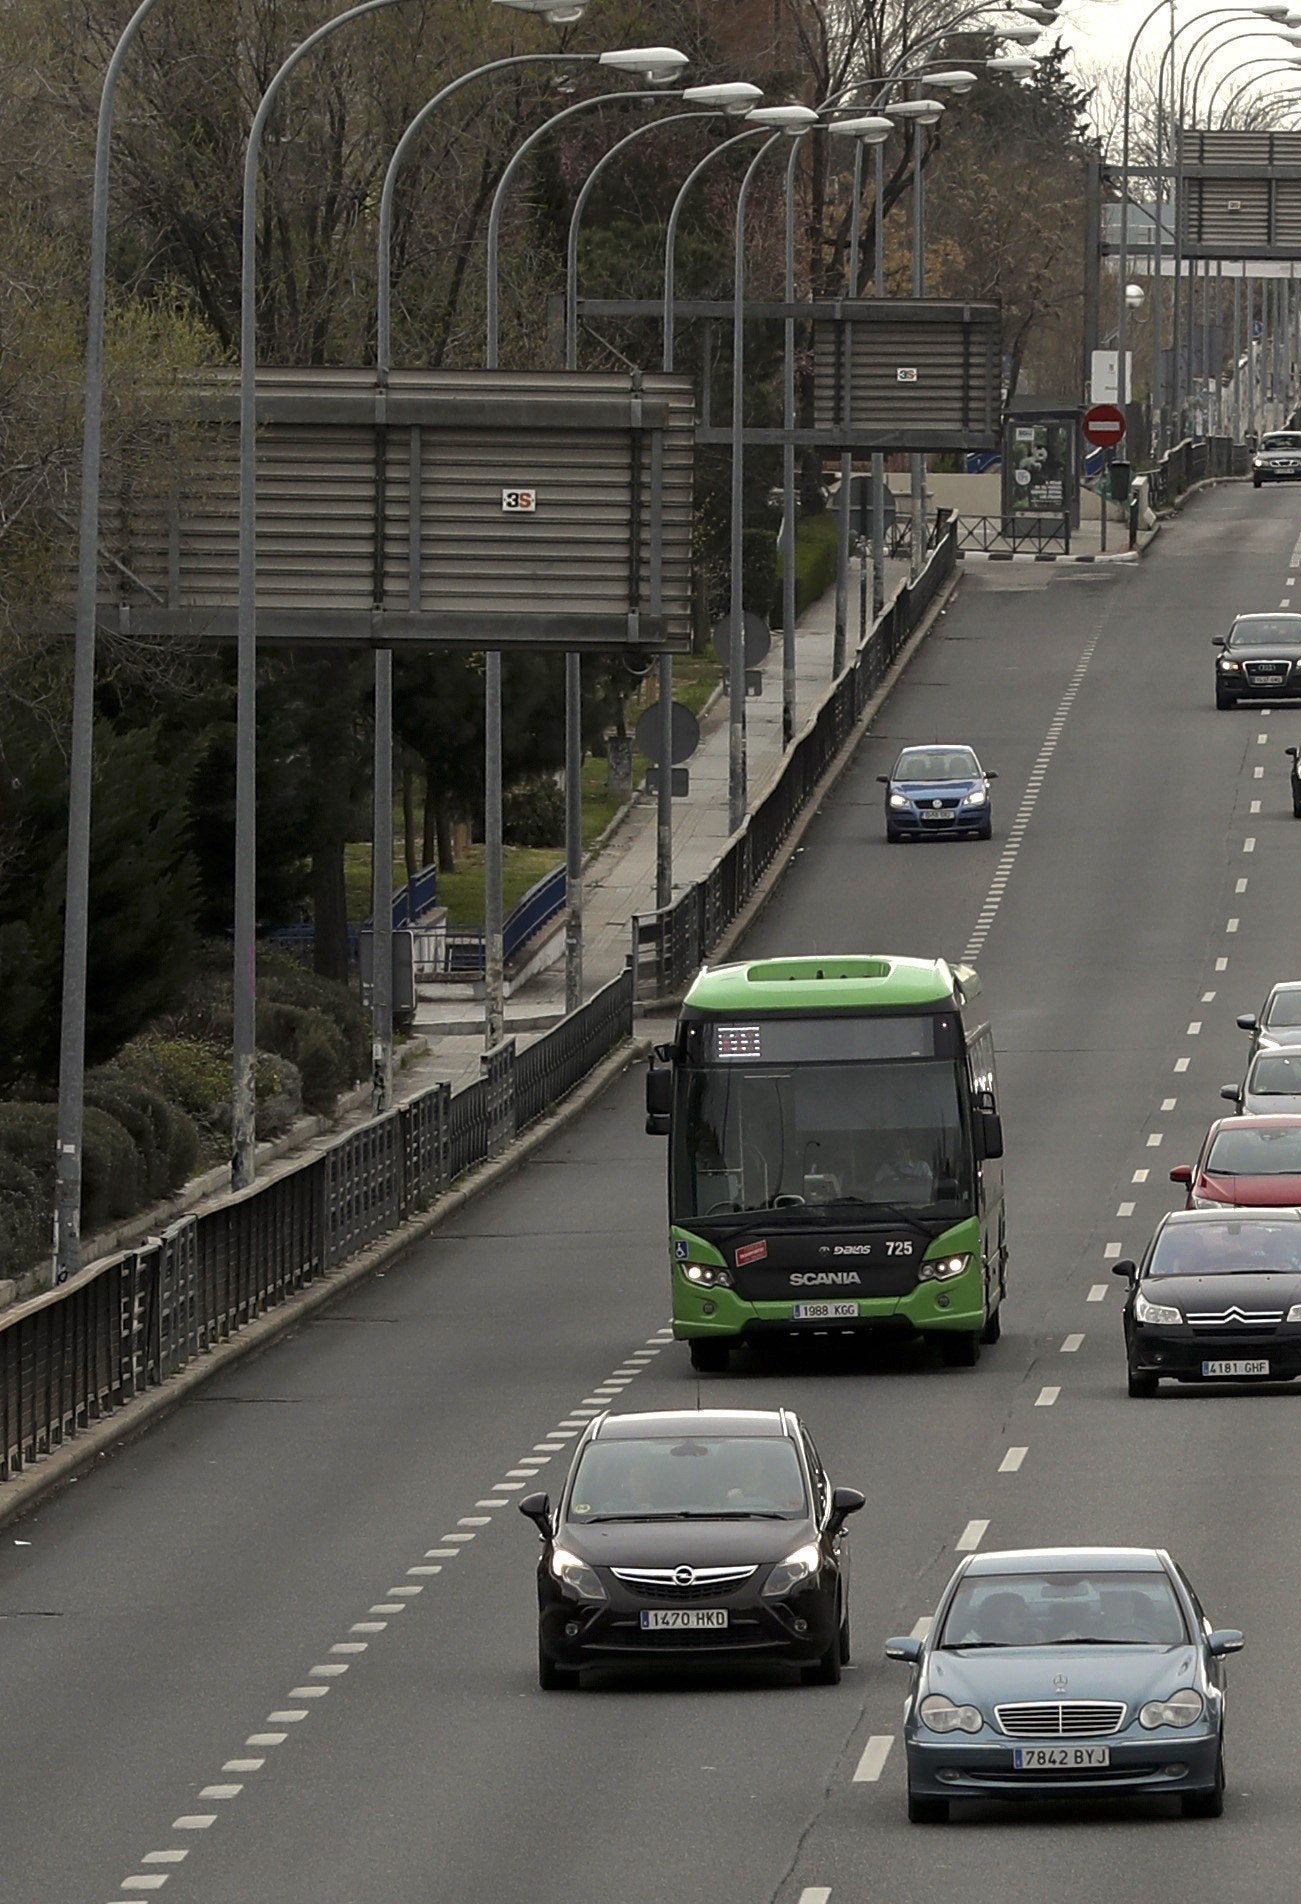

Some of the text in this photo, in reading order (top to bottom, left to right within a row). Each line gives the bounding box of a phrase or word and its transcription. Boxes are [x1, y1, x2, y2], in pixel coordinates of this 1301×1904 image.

[505, 492, 532, 508] 3S
[885, 1241, 913, 1256] 725
[789, 1271, 861, 1286] SCANIA
[803, 1304, 855, 1317] 1988 KGG
[1209, 1361, 1267, 1374] 4181 GHF
[651, 1610, 726, 1628] 1470 HKD
[1025, 1748, 1107, 1766] 7842 BYJ
